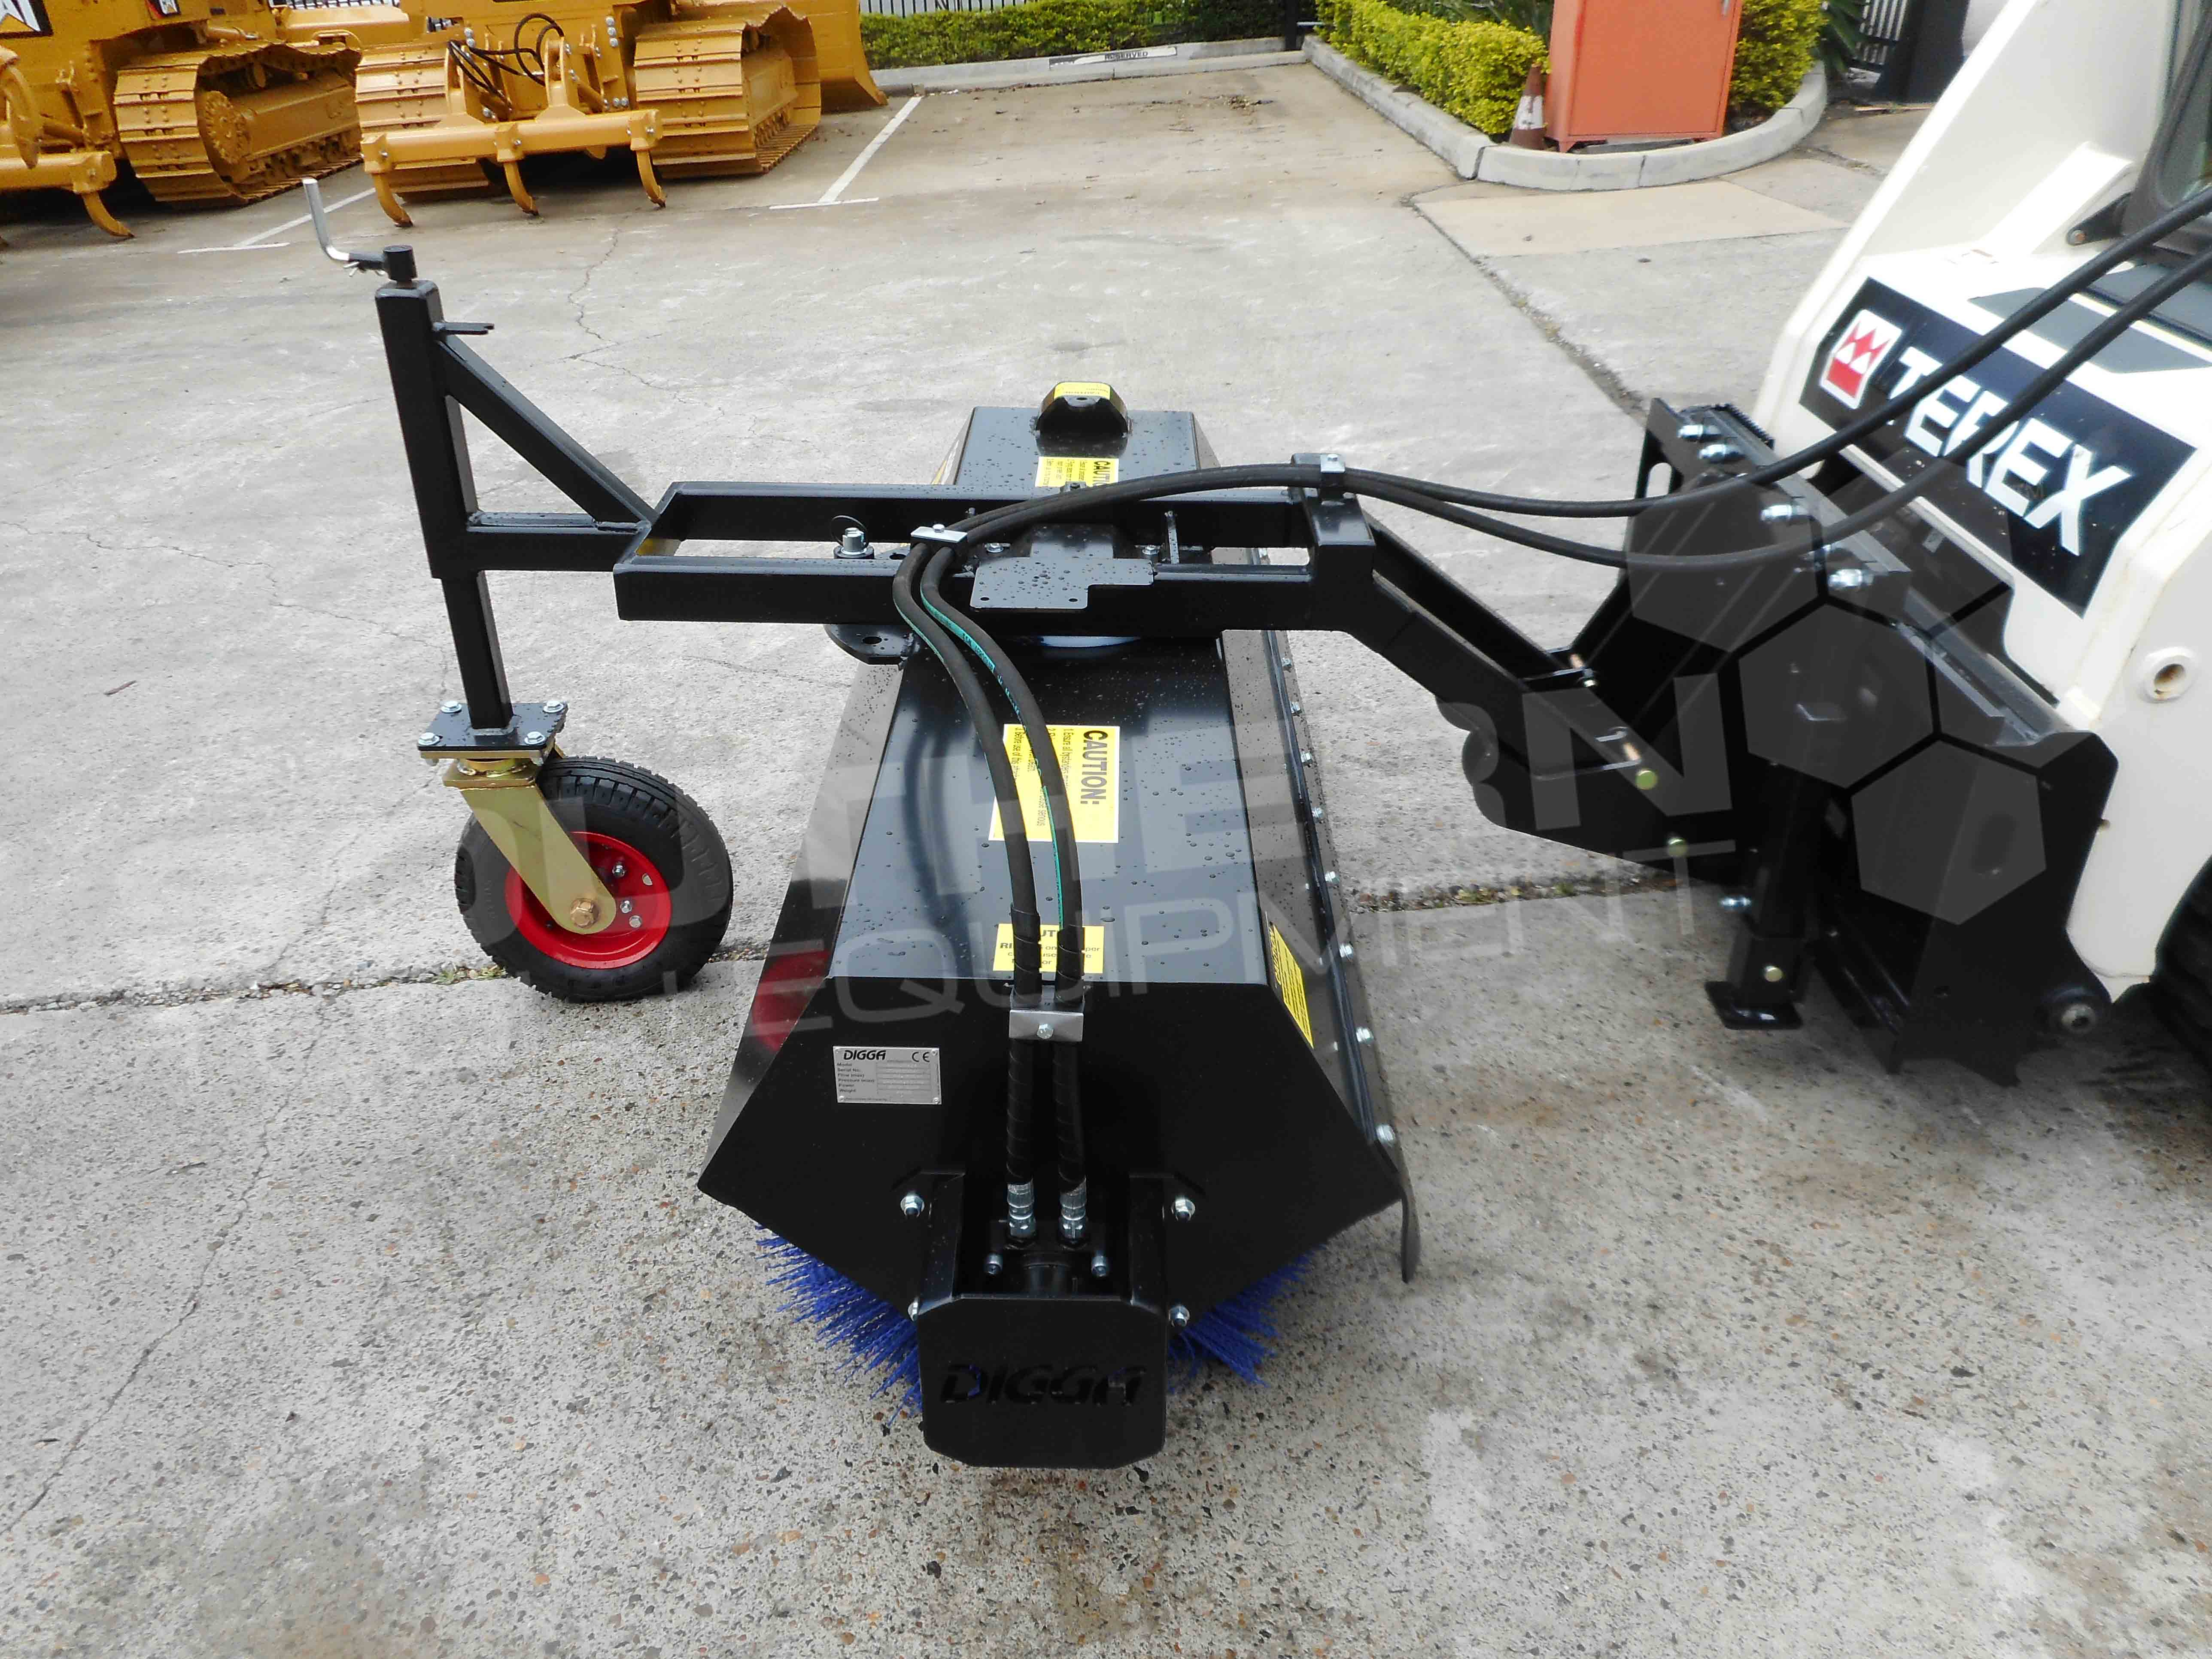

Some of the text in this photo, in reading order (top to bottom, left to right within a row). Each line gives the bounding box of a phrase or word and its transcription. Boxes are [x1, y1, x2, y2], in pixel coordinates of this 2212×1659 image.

[1887, 346, 2133, 556] TEREX
[1014, 732, 1025, 744] Before
[1063, 732, 1073, 745] Ensure
[1081, 730, 1108, 805] CAUTION:
[843, 1050, 886, 1060] DIGGA
[942, 1364, 1146, 1405] DIGGA
